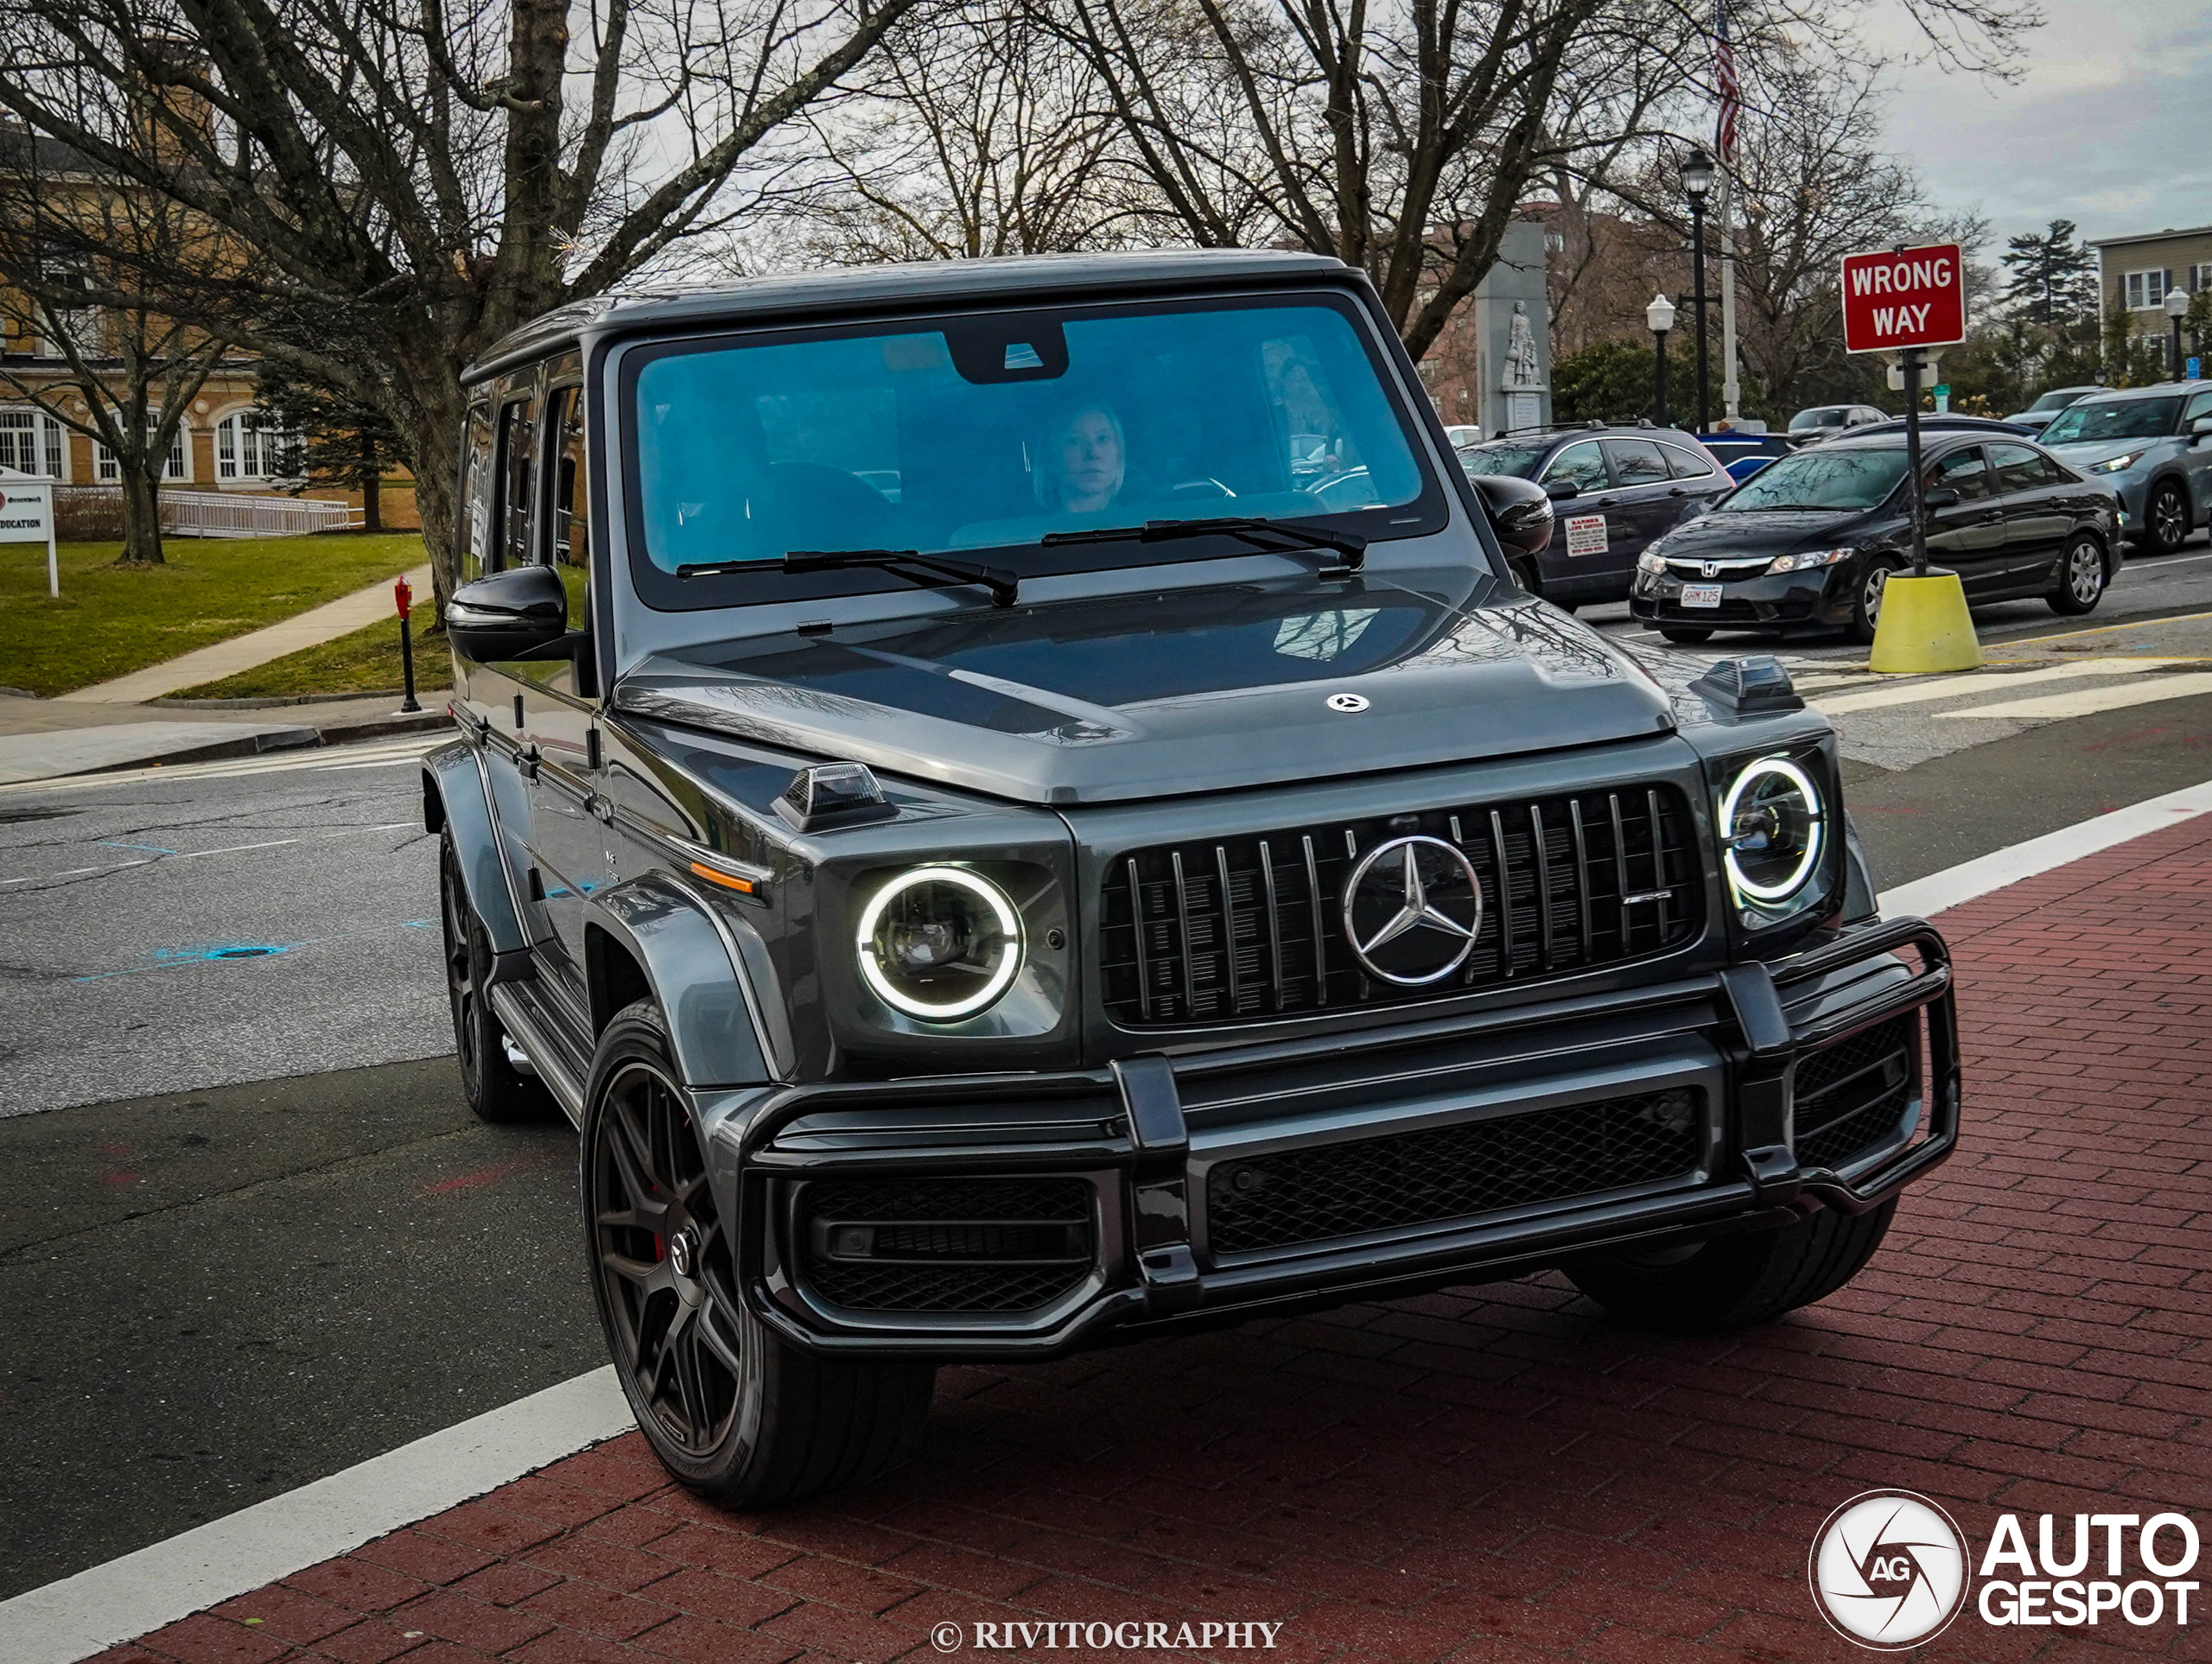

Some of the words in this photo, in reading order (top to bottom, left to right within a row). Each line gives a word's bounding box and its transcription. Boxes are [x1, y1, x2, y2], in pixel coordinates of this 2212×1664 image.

[1852, 258, 1952, 296] WRONG
[1872, 303, 1931, 336] WAY
[0, 519, 41, 529] DUCATION
[1702, 591, 1719, 602] 125
